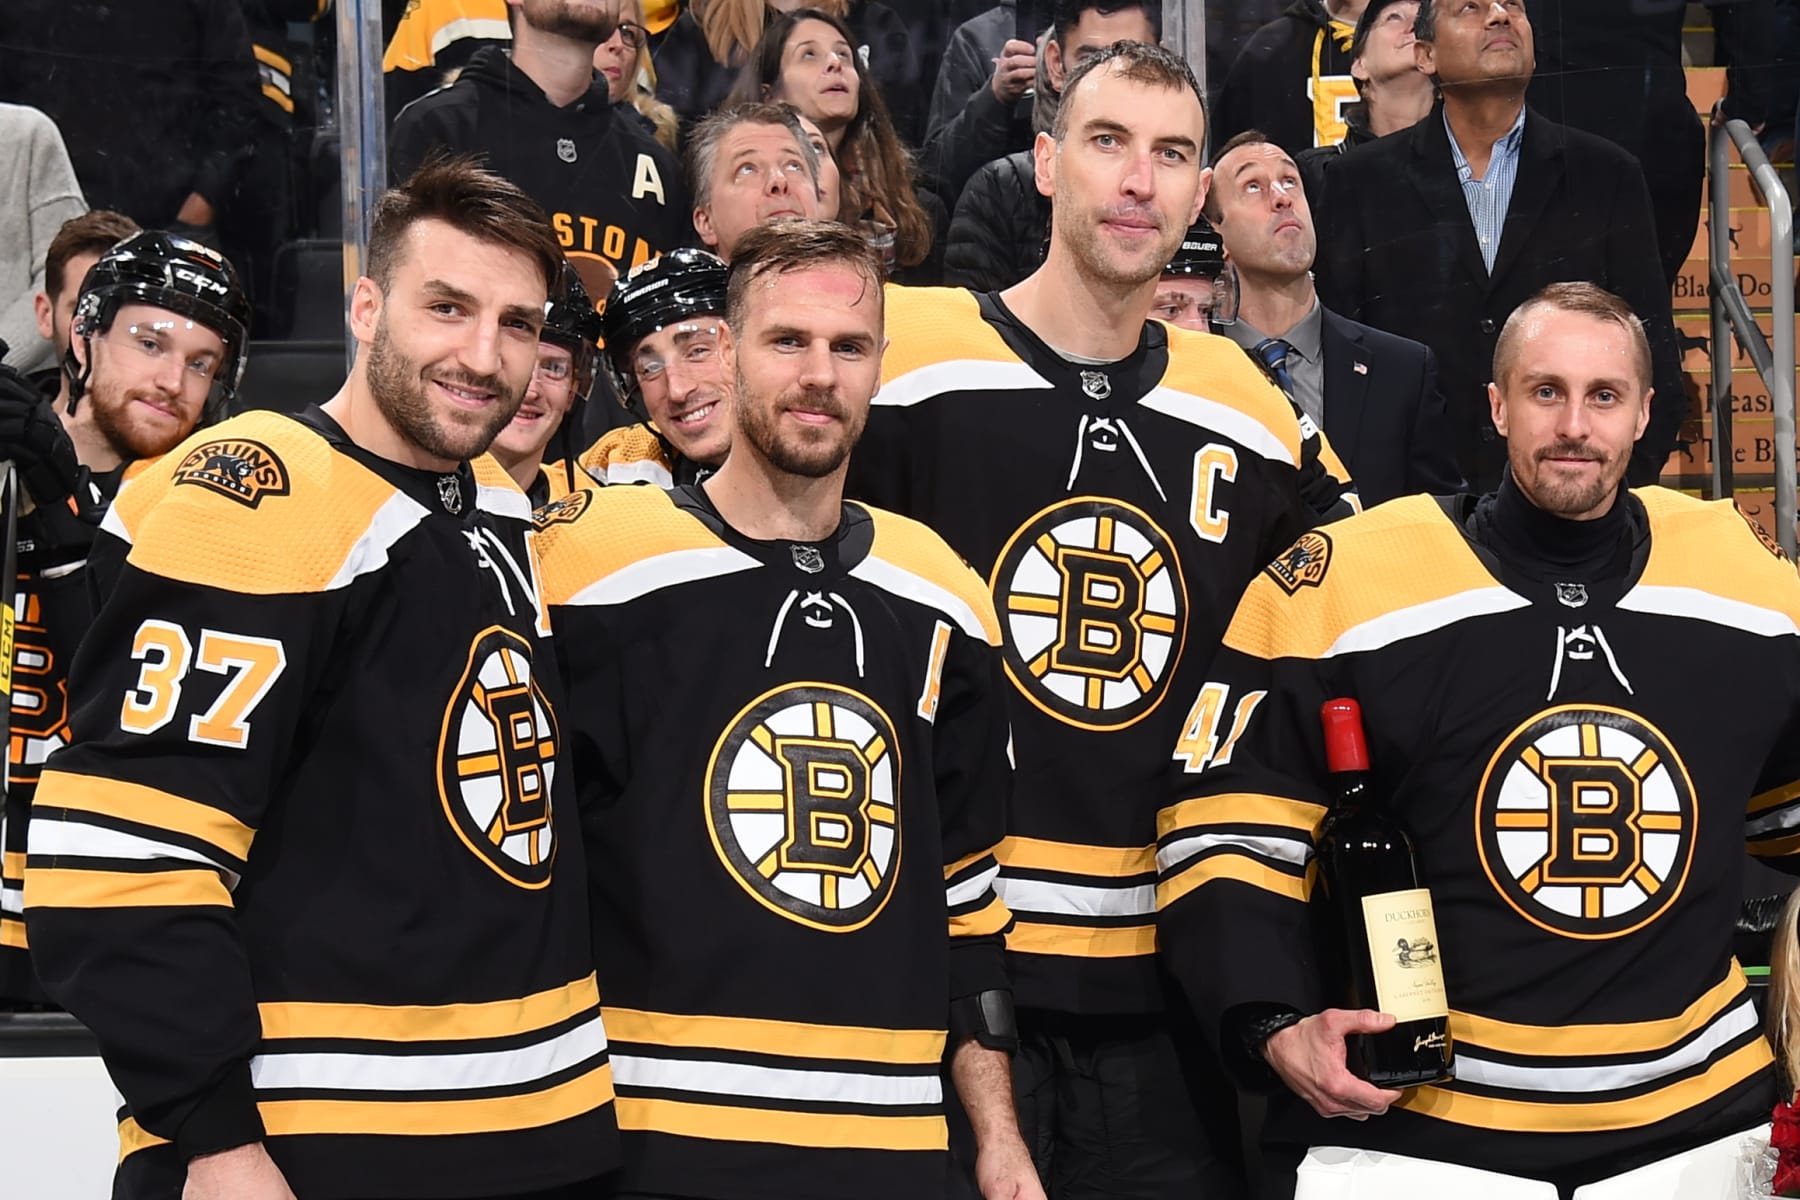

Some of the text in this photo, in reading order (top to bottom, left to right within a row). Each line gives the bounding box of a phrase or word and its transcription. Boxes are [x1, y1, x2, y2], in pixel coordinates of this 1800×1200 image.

[632, 153, 666, 205] A
[176, 267, 228, 295] CCM
[1182, 241, 1218, 252] BAUER
[183, 443, 277, 487] BRUINS
[1190, 442, 1239, 543] C
[2, 618, 12, 680] CCM
[1051, 547, 1145, 679] B
[120, 618, 287, 749] 37
[1172, 681, 1268, 774] 41
[486, 685, 547, 832] B
[775, 737, 873, 875] B
[1542, 758, 1641, 884] B
